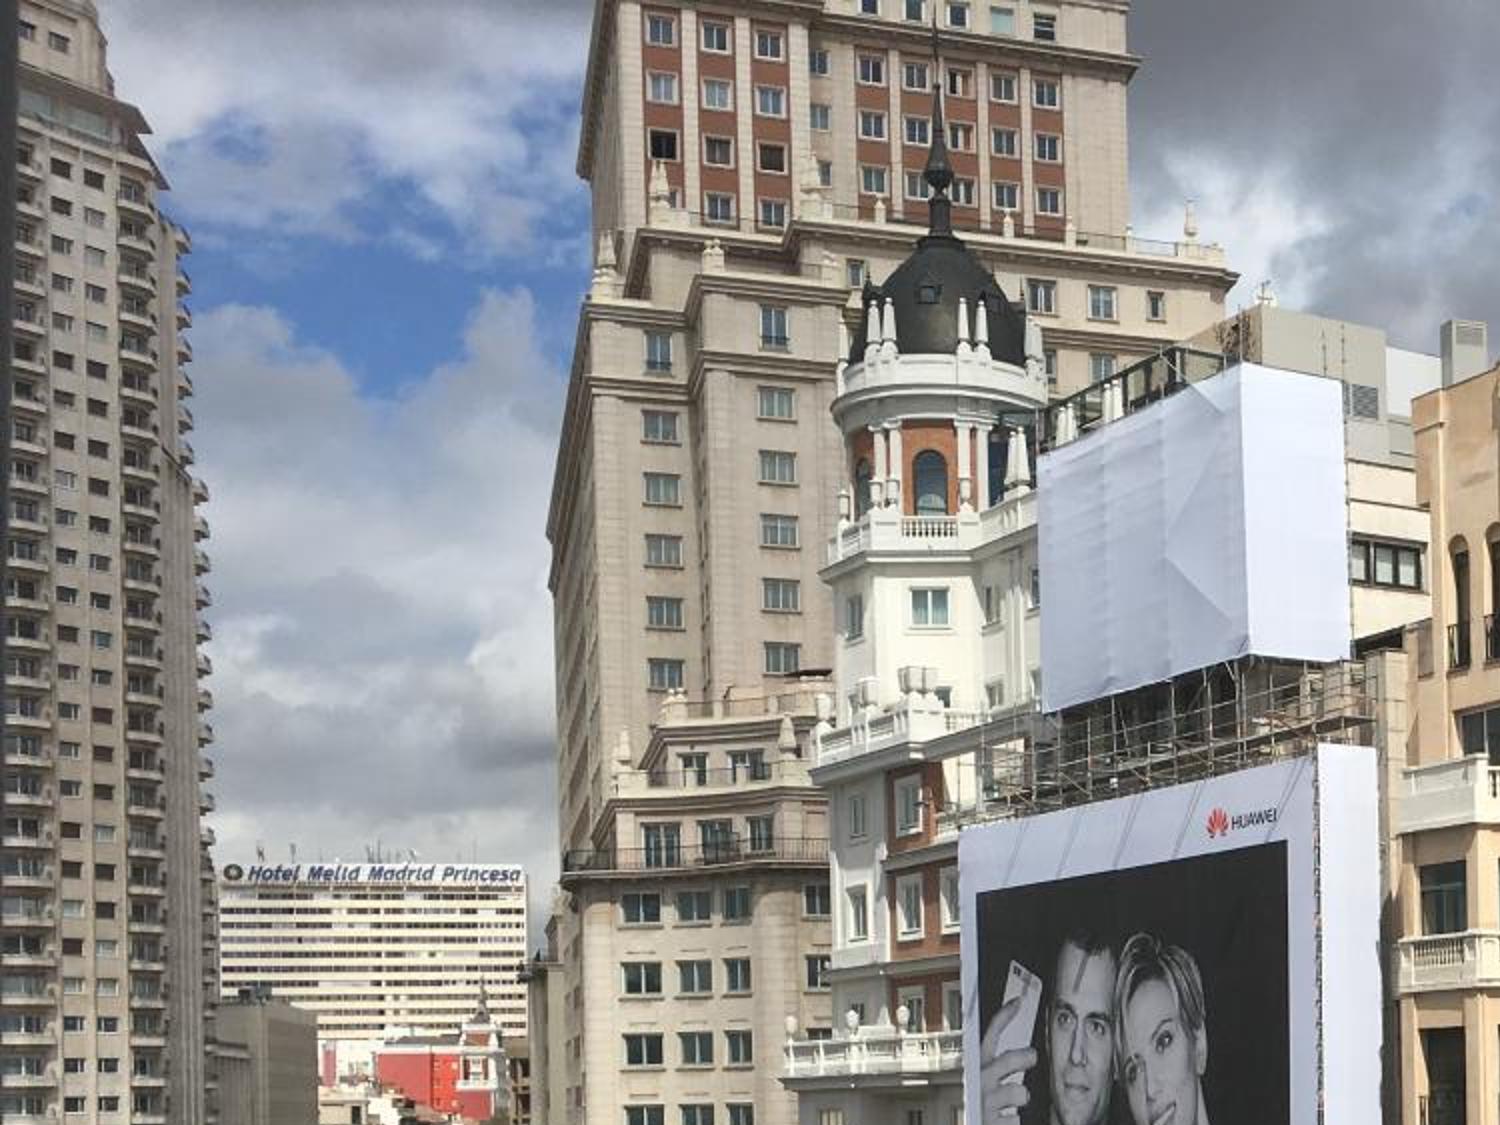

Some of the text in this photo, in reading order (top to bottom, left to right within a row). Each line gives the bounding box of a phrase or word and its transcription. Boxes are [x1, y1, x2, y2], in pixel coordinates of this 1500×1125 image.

[1231, 807, 1278, 830] HUAWEI
[248, 864, 300, 882] Hotel
[367, 864, 436, 882] Madrid
[442, 865, 521, 882] Princesa
